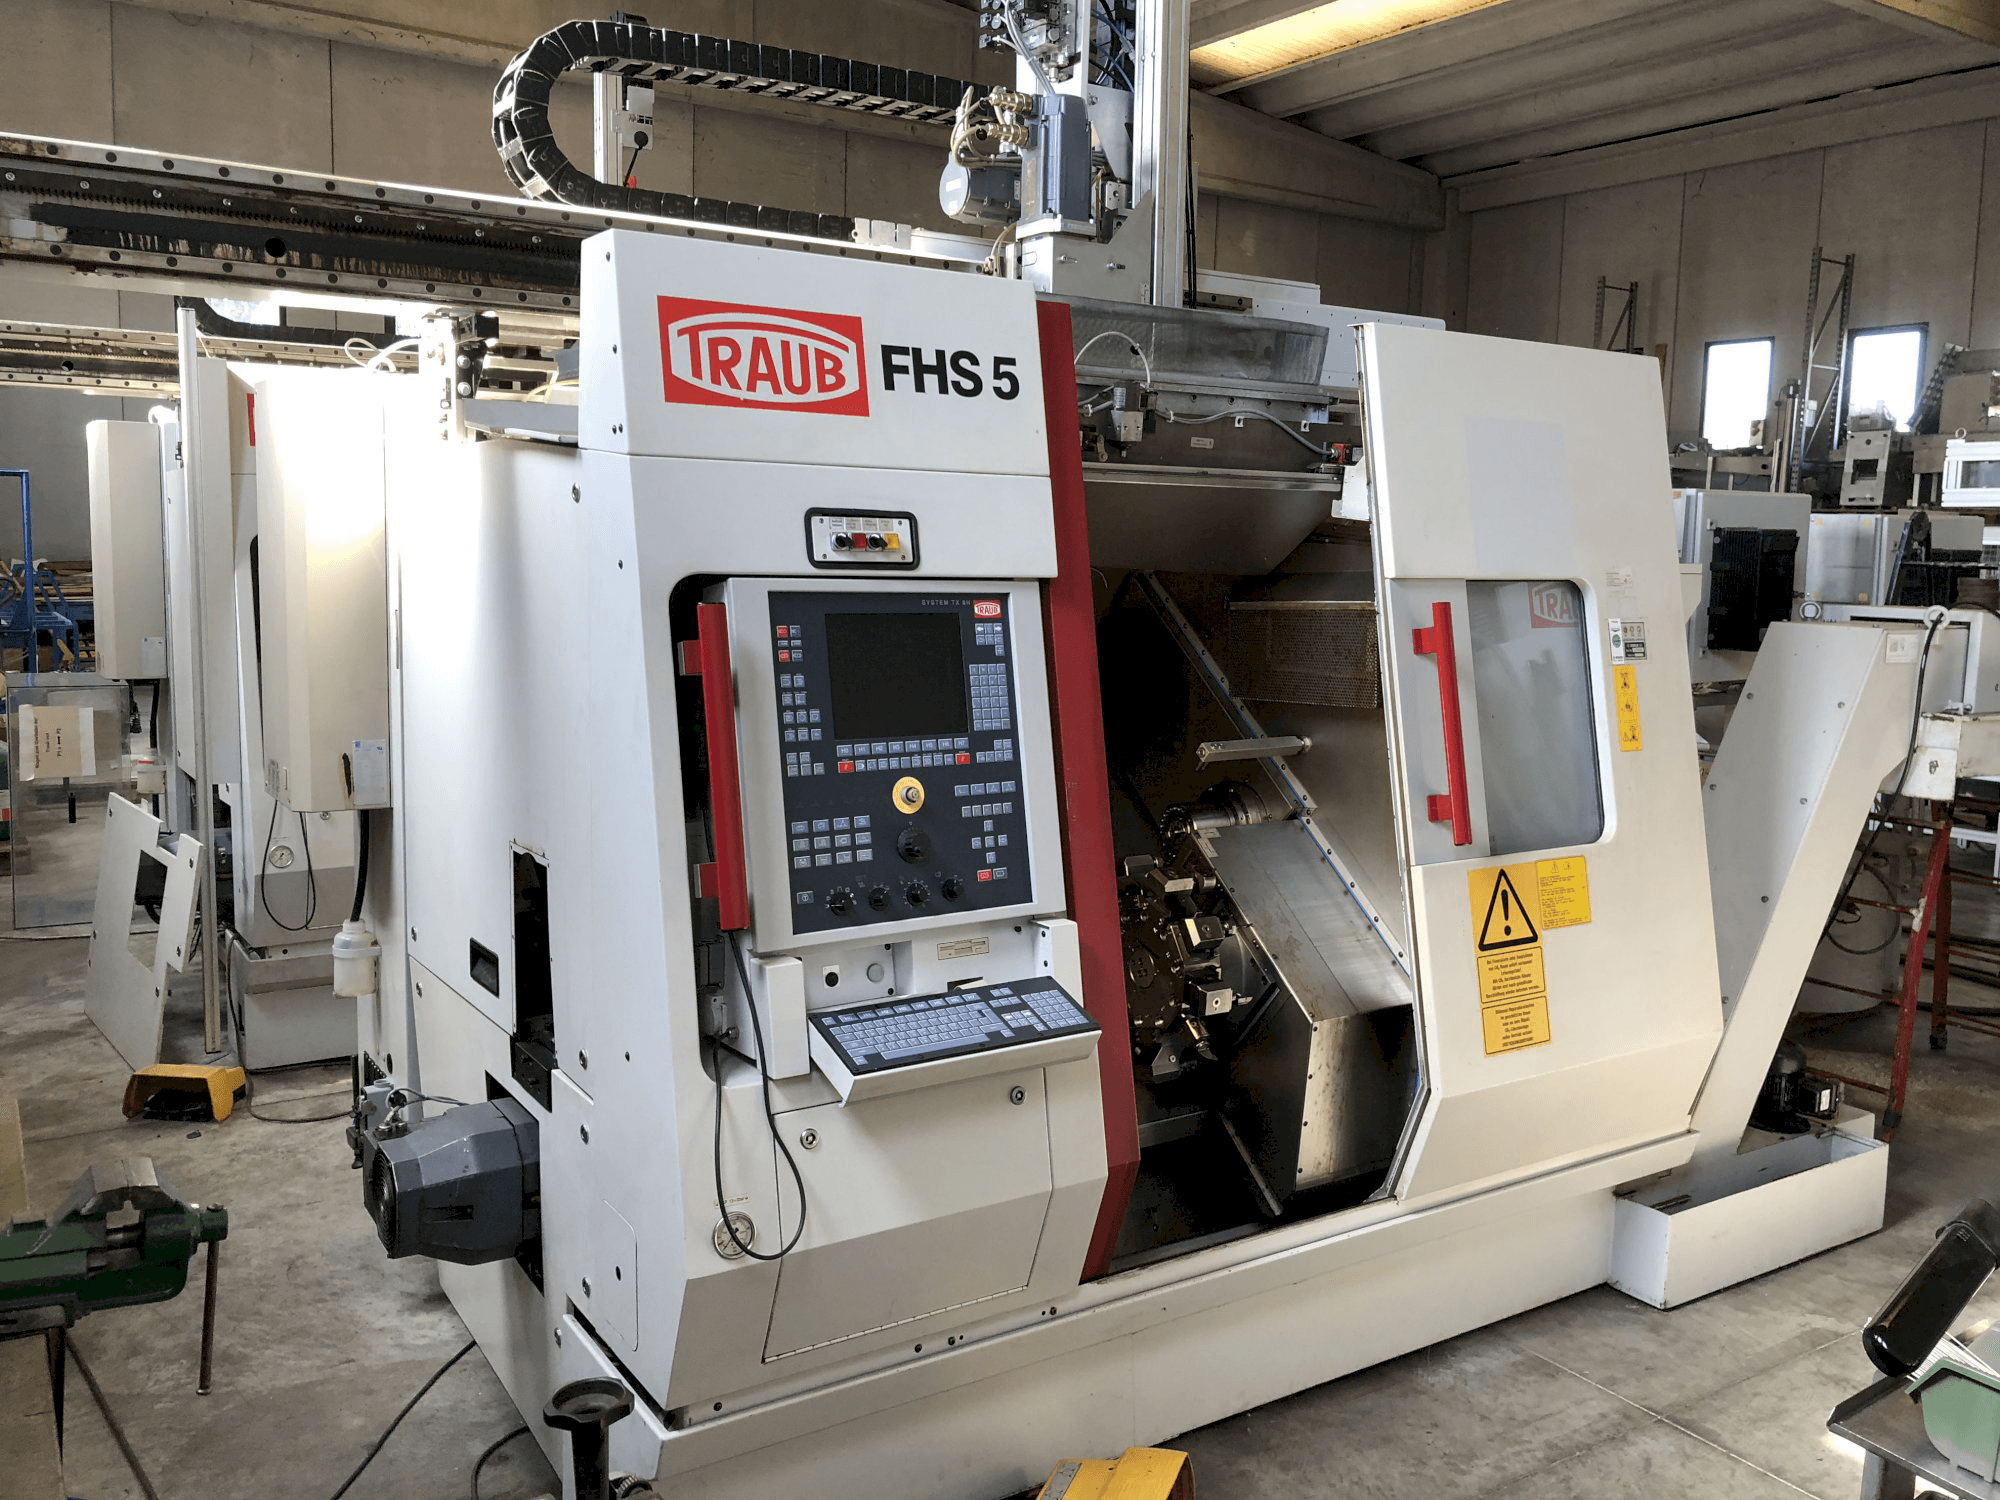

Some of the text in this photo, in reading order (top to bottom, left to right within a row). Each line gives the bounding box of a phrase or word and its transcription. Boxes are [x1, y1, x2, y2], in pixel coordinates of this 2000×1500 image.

[676, 321, 849, 396] TRAUB
[880, 344, 1020, 401] FHS 5
[975, 602, 998, 615] TRAUB
